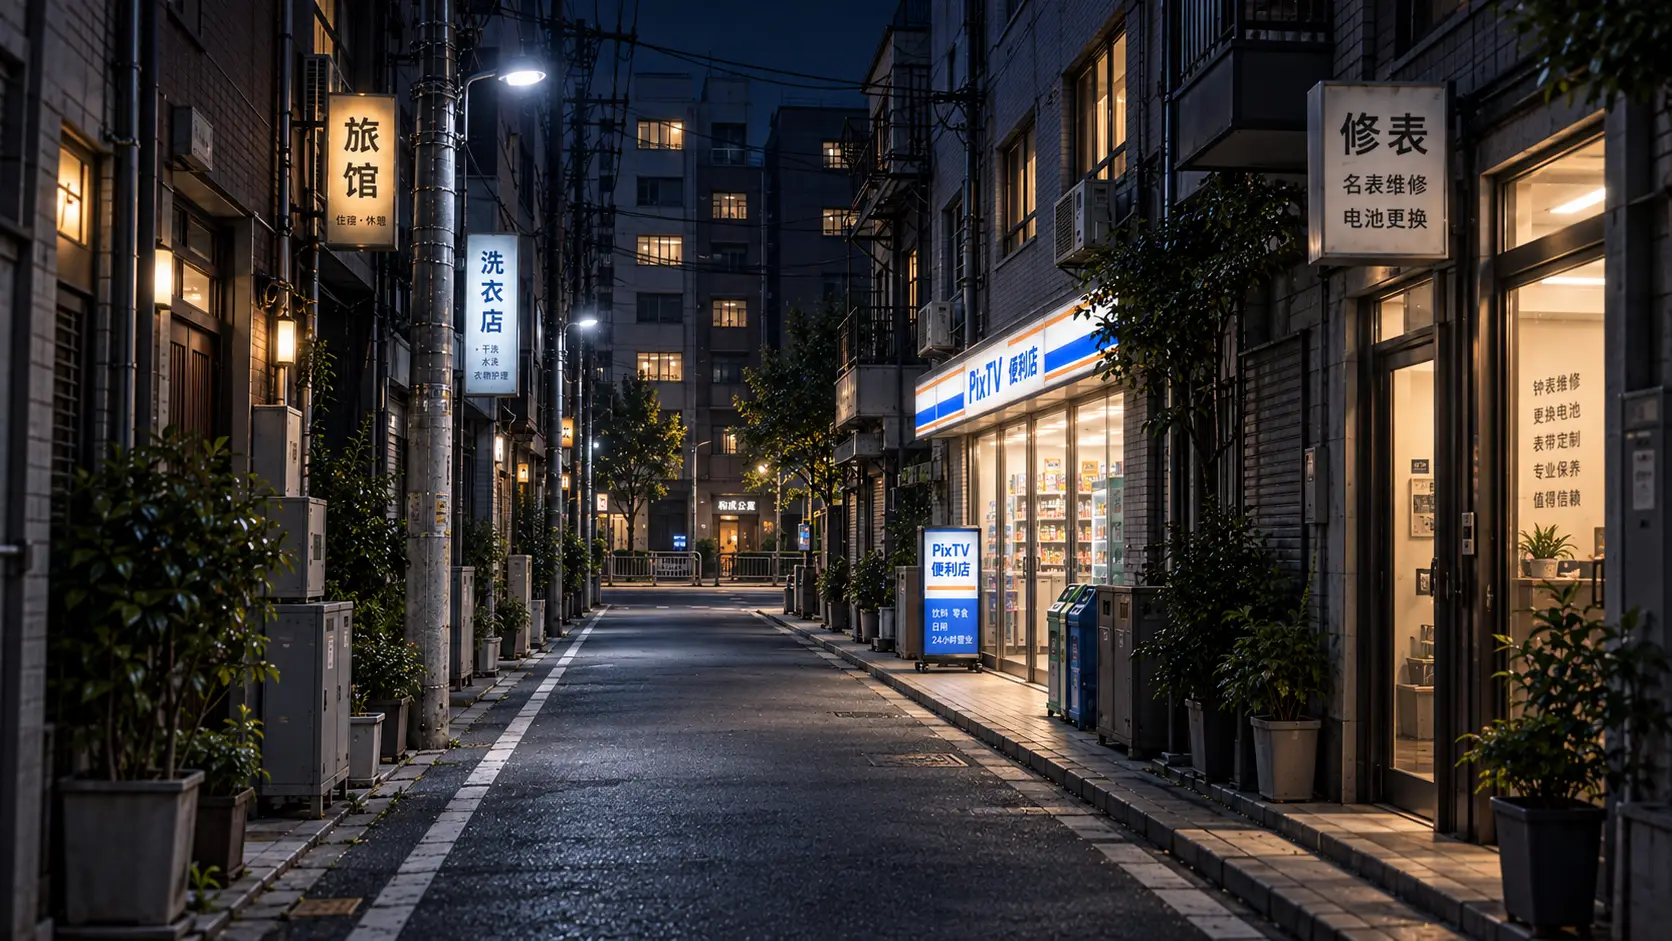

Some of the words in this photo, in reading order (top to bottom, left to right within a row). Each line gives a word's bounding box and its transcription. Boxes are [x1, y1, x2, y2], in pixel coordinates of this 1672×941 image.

[1340, 112, 1428, 156] 修表
[343, 117, 379, 199] 旅馆
[1342, 173, 1428, 196] 名表维修
[1343, 208, 1428, 229] 电池更换
[480, 250, 504, 334] 洗衣店
[968, 356, 1003, 405] PixTV
[1008, 345, 1039, 386] 便利店
[1533, 372, 1581, 397] 钟表维修
[1533, 401, 1581, 425] 更换电池
[1532, 430, 1581, 453] 表带定制
[1533, 459, 1581, 480] 专业保养
[932, 543, 971, 558] PixTV
[931, 561, 971, 578] 便利店
